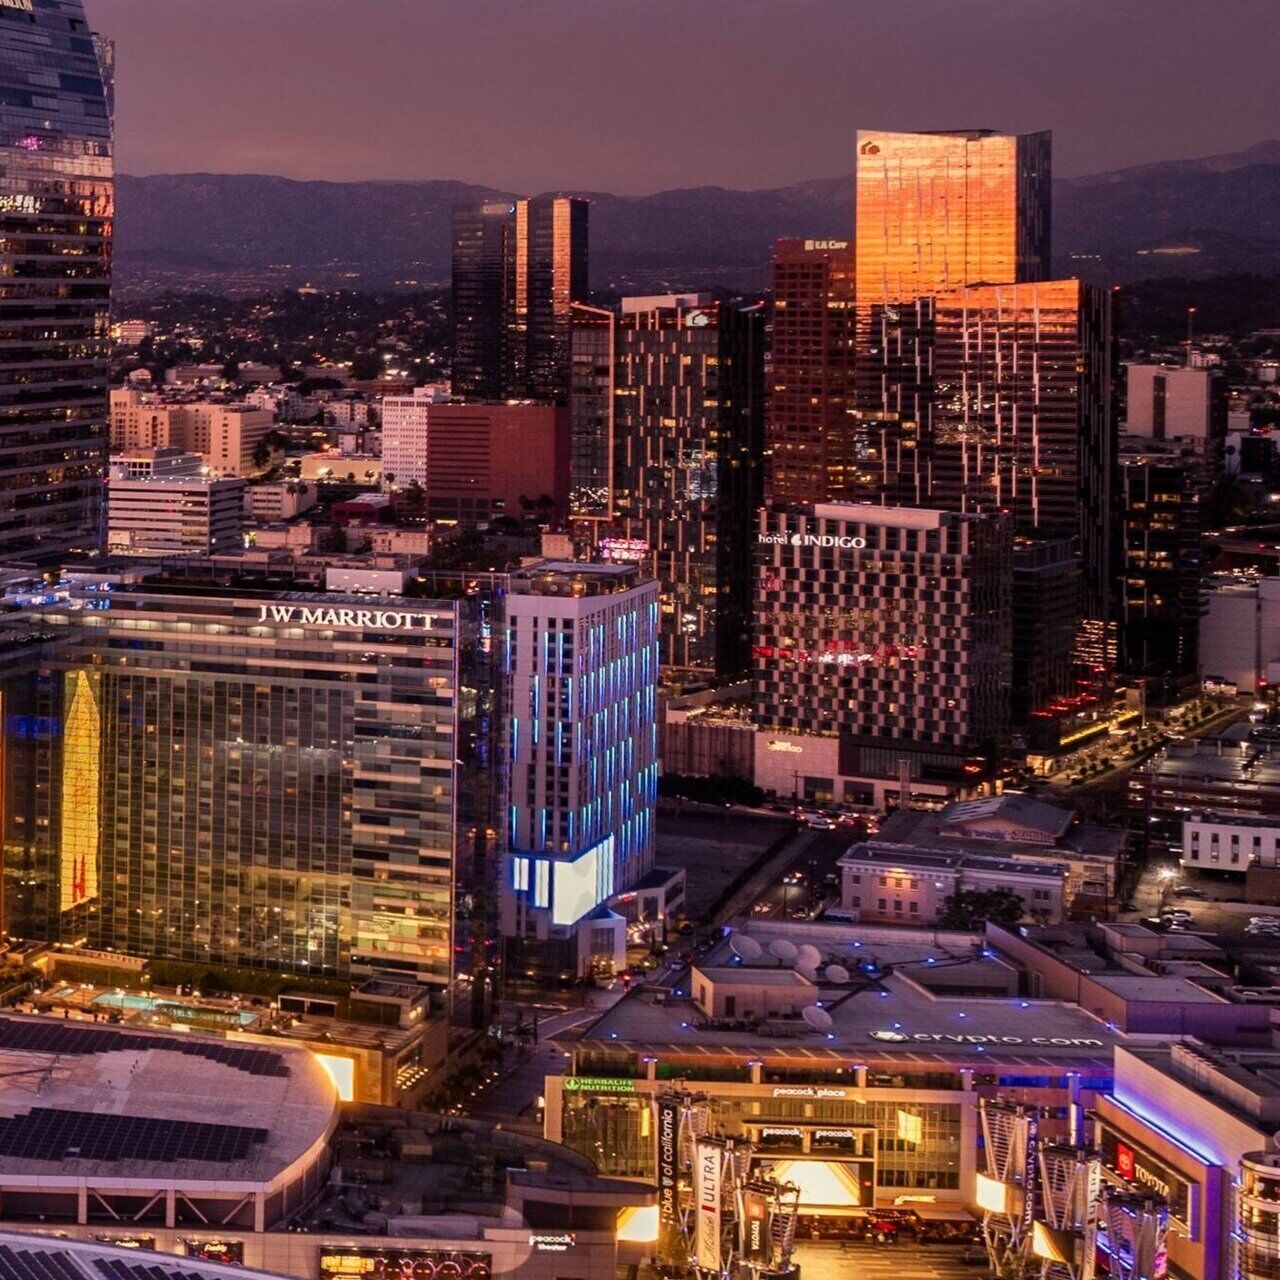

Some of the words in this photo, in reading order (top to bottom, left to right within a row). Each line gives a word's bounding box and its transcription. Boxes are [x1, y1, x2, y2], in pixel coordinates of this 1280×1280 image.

[758, 534, 788, 545] hotel
[804, 535, 866, 549] INDIGO
[299, 607, 438, 631] MARRIOTT
[913, 1032, 1104, 1047] crypto.com
[580, 1077, 634, 1085] HERBALIFE
[773, 1087, 815, 1098] peacock
[816, 1087, 846, 1098] place
[661, 1108, 674, 1162] california
[762, 1127, 801, 1138] peacock
[815, 1129, 854, 1139] peacock
[663, 1162, 674, 1175] of
[703, 1154, 716, 1203] ULTRA
[1023, 1141, 1036, 1226] crypto.com
[1133, 1163, 1171, 1196] TOYOTA
[661, 1190, 674, 1213] blue
[529, 1234, 572, 1246] peacock
[750, 1220, 761, 1251] TOYOTA
